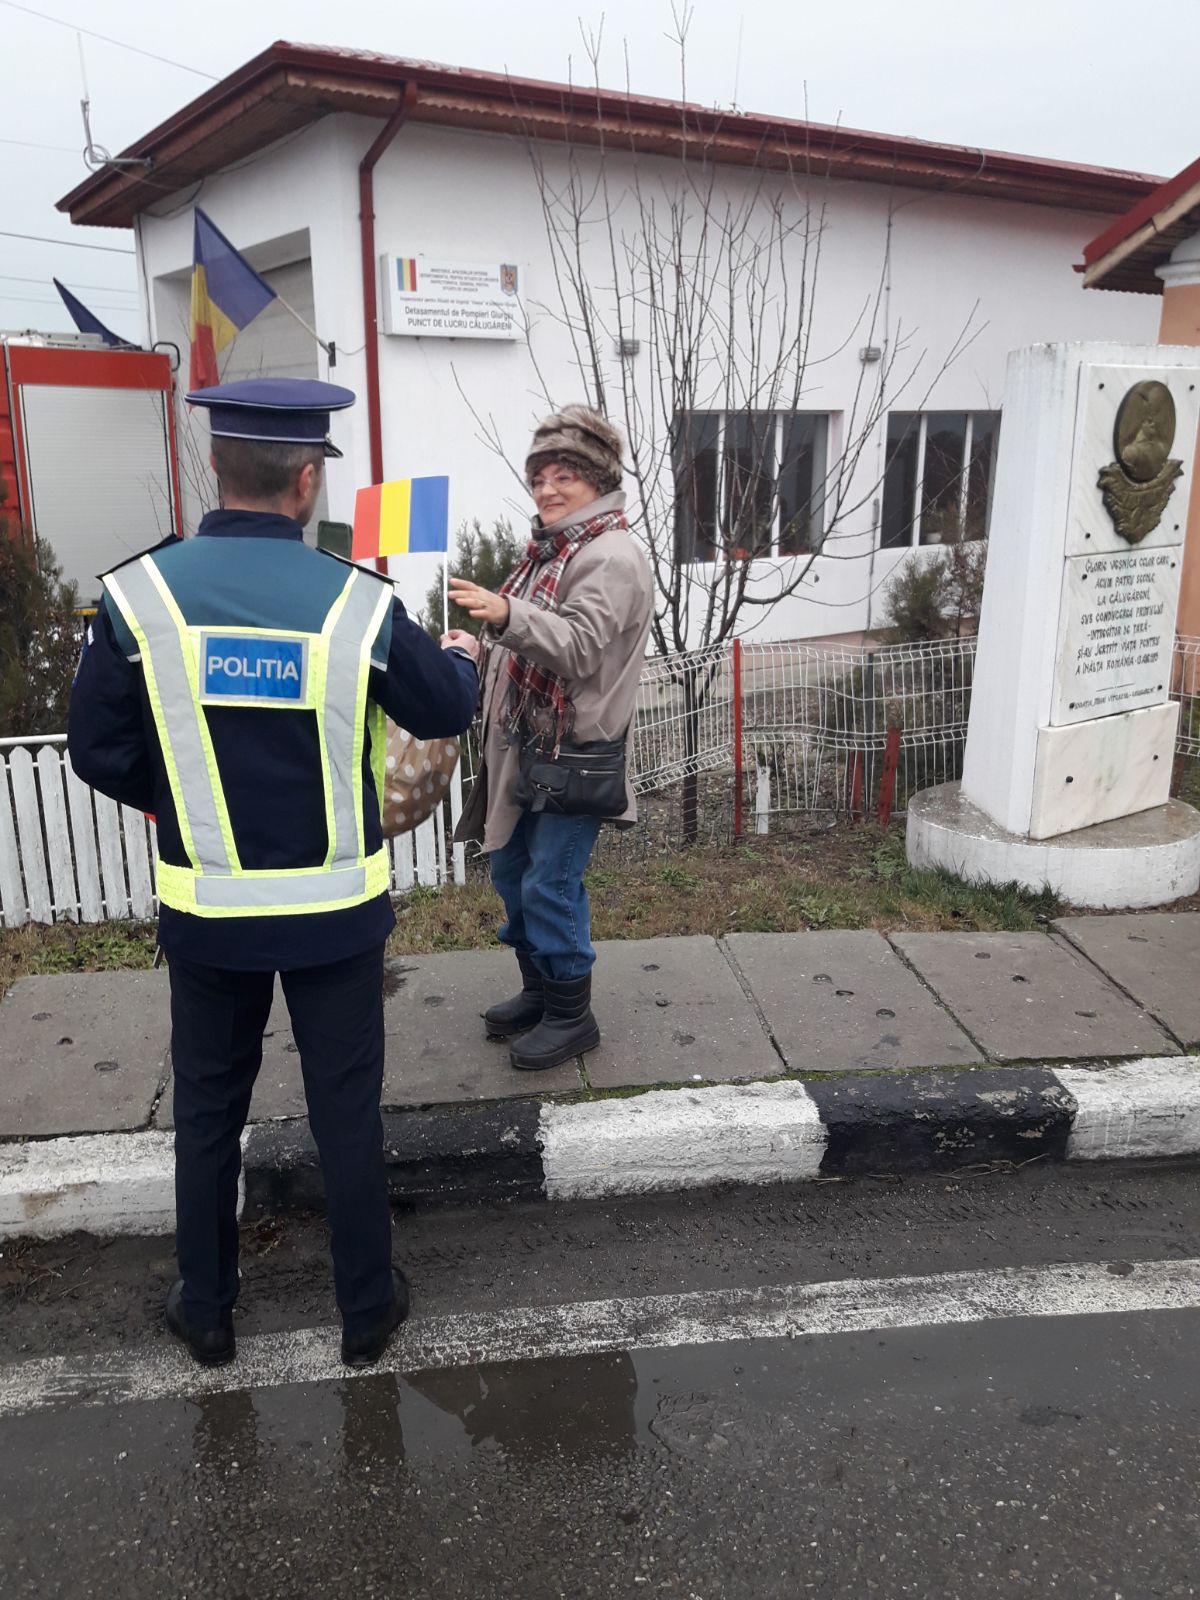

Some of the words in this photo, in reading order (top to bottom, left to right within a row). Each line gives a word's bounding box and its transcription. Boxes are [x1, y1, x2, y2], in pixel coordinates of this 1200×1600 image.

[452, 309, 460, 317] de
[461, 309, 489, 320] Pompieri
[408, 318, 431, 327] PUNCT
[433, 319, 443, 328] DE
[444, 320, 468, 329] LUCRU
[1097, 595, 1106, 606] LA
[207, 656, 299, 681] POLITIA
[1075, 664, 1081, 676] A
